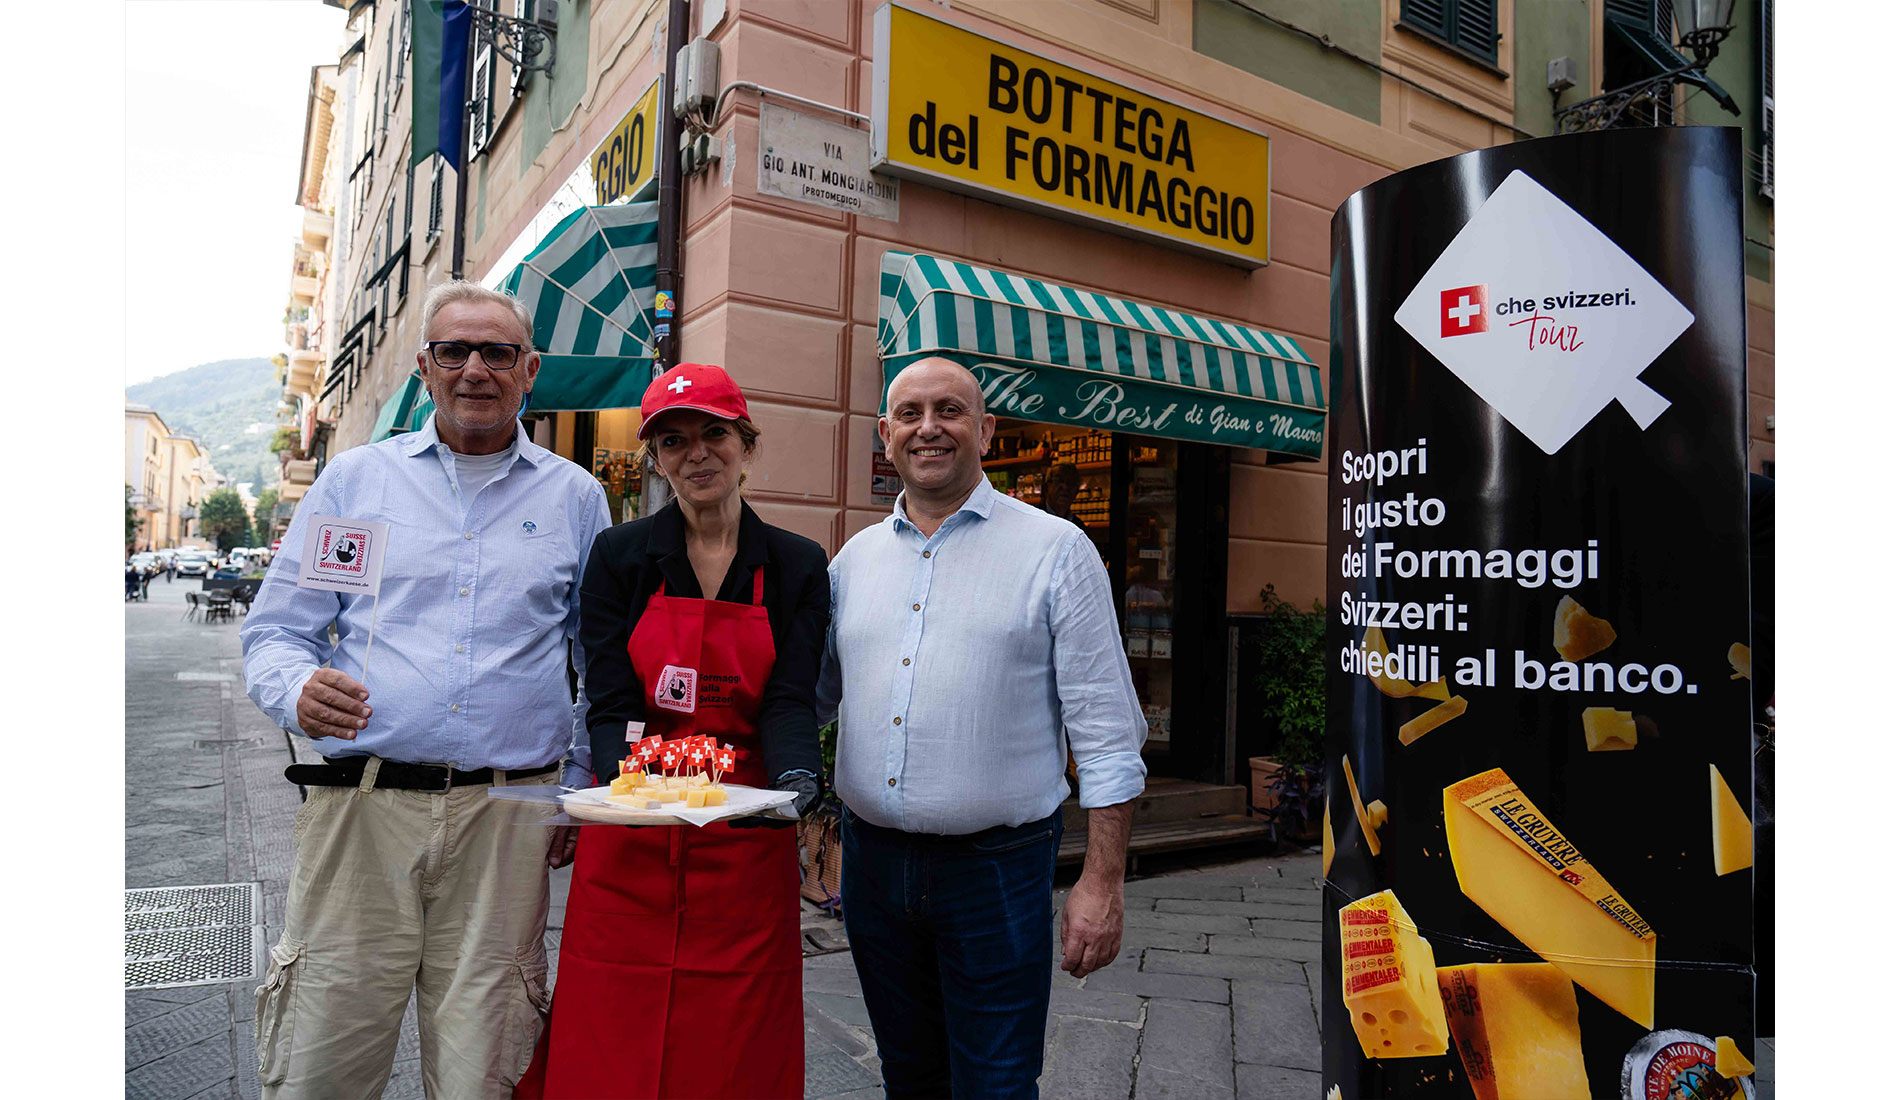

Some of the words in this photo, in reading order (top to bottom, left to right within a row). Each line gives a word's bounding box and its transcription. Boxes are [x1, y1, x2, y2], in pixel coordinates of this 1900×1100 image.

[988, 53, 1195, 172] BOTTEGA
[823, 142, 843, 161] VIA
[908, 101, 979, 171] del
[1005, 126, 1254, 246] FORMAGGIO
[763, 155, 787, 175] GIO.
[791, 161, 817, 182] ANT.
[821, 169, 897, 202] MONGIARDINI
[802, 183, 862, 209] (PROTOMEDICO)
[1495, 297, 1537, 316] che
[1543, 287, 1636, 311] svizzeri.
[969, 362, 1045, 415] The
[1058, 379, 1178, 432] Best
[1185, 403, 1203, 426] di
[1209, 405, 1252, 435] Gian
[1255, 420, 1264, 434] e
[1270, 413, 1323, 444] Mauro
[1342, 438, 1428, 486] Scopri
[1342, 498, 1351, 531] il
[1354, 492, 1446, 538] gusto
[322, 530, 332, 554] SCHWEIZ
[356, 541, 365, 566] SVIZZERA
[1341, 544, 1367, 578] dei
[1374, 539, 1598, 589] Formaggi
[320, 562, 361, 572] SWITZERLAND
[1340, 590, 1468, 632] Svizzeri:
[1340, 640, 1440, 683] chiedili
[1455, 649, 1496, 687] al
[1514, 650, 1698, 694] banco.
[1500, 798, 1527, 816] LE
[1493, 808, 1562, 868] SWITZERLAND
[1652, 1054, 1668, 1074] DE
[1666, 1045, 1711, 1063] MOINE
